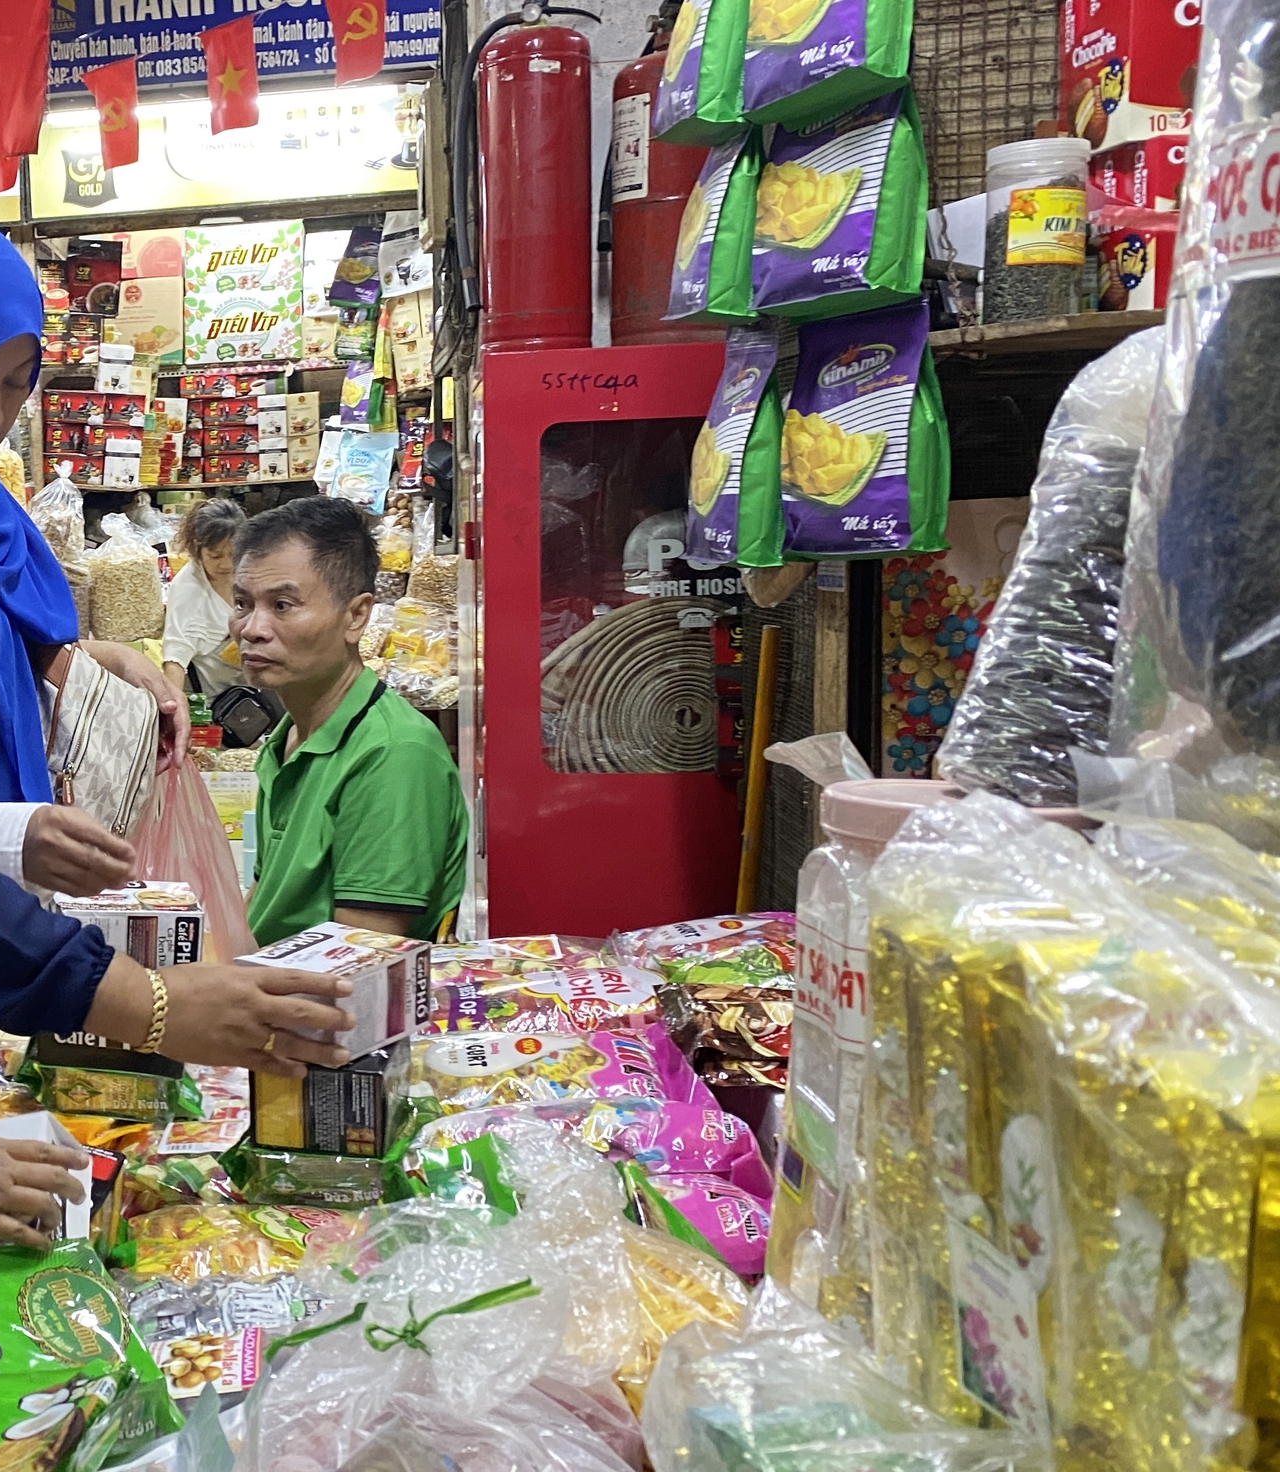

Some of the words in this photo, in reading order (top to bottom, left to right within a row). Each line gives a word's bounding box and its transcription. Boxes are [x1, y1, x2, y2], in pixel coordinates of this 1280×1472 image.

[51, 37, 87, 62] Chuyên
[89, 36, 107, 58] bán
[278, 21, 303, 41] bánh
[305, 18, 326, 43] đậu
[403, 8, 440, 34] nguyên
[315, 42, 330, 64] SỐ
[829, 35, 855, 57] sấy
[1149, 114, 1168, 132] 10
[78, 183, 103, 197] GOLD
[1044, 217, 1071, 232] KIM
[250, 243, 279, 264] VIP
[250, 311, 279, 332] VIP
[872, 513, 899, 535] sấy
